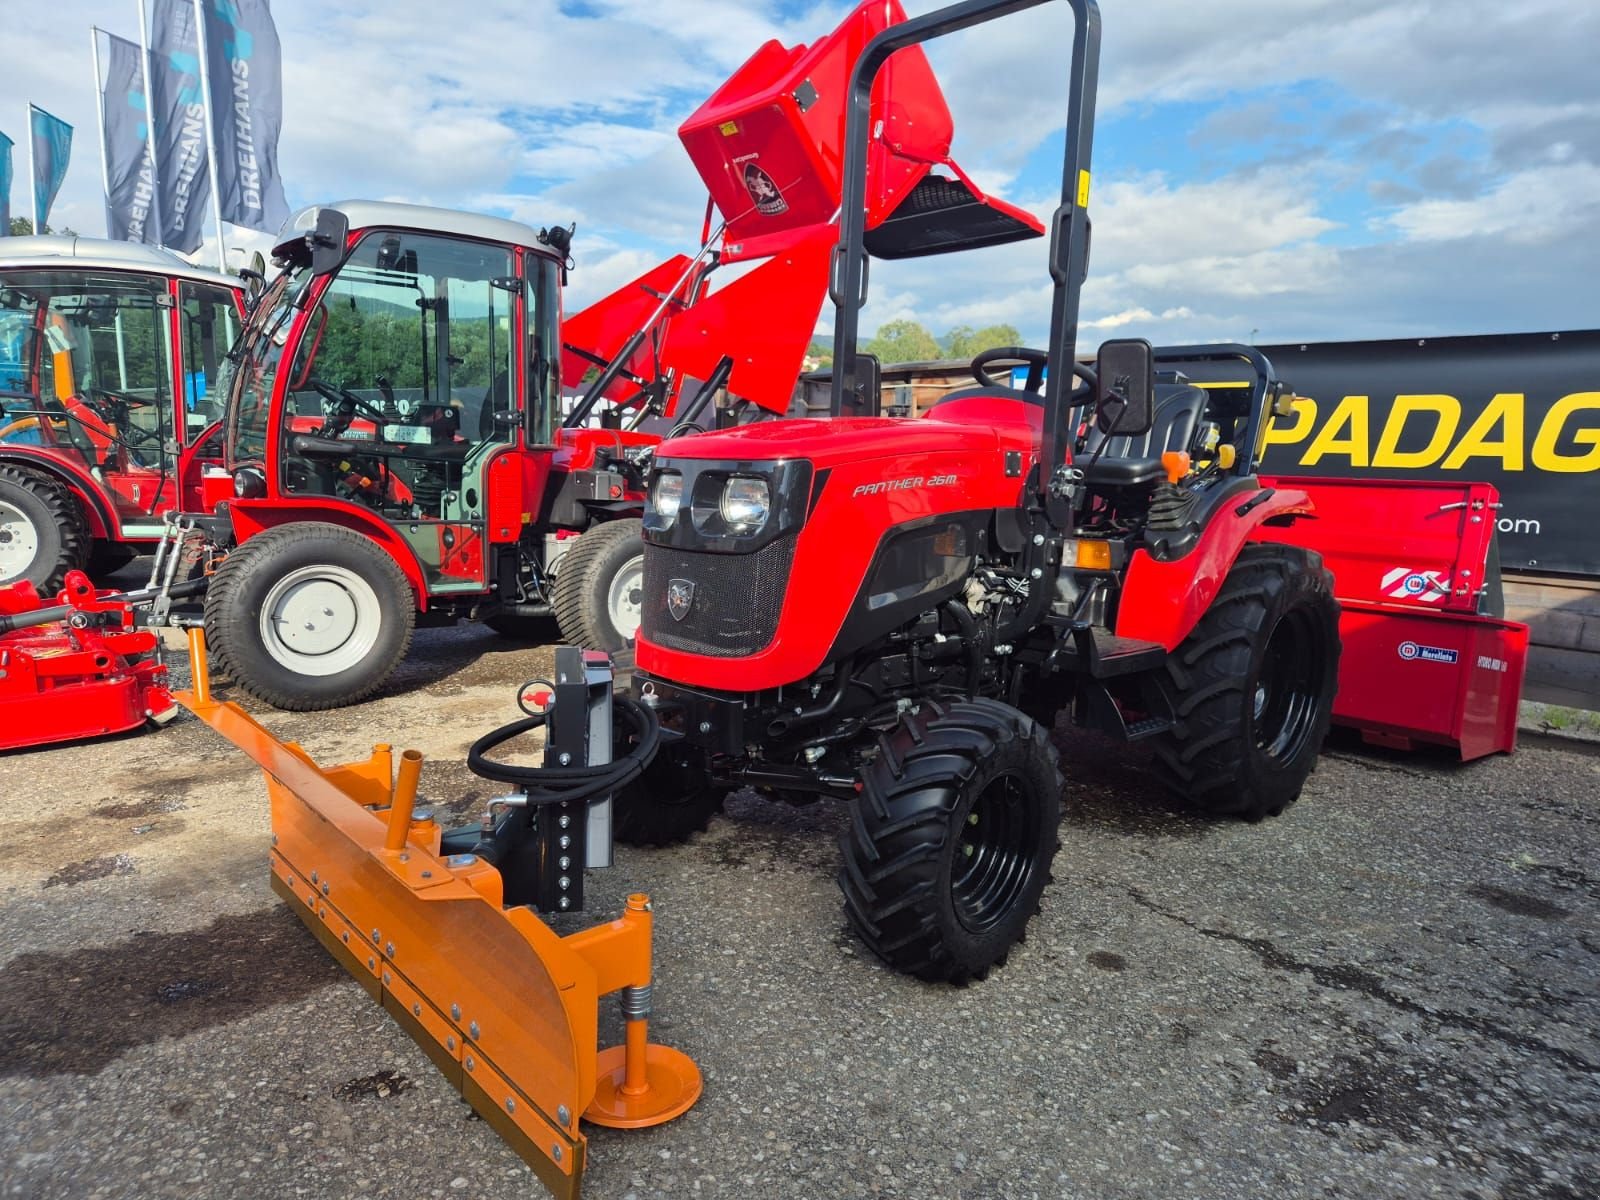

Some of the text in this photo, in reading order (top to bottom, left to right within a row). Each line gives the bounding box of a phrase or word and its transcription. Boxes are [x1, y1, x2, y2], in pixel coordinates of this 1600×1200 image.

[231, 58, 261, 209] DREIHANS
[853, 475, 957, 497] PANTHER 26M
[1495, 517, 1540, 535] om
